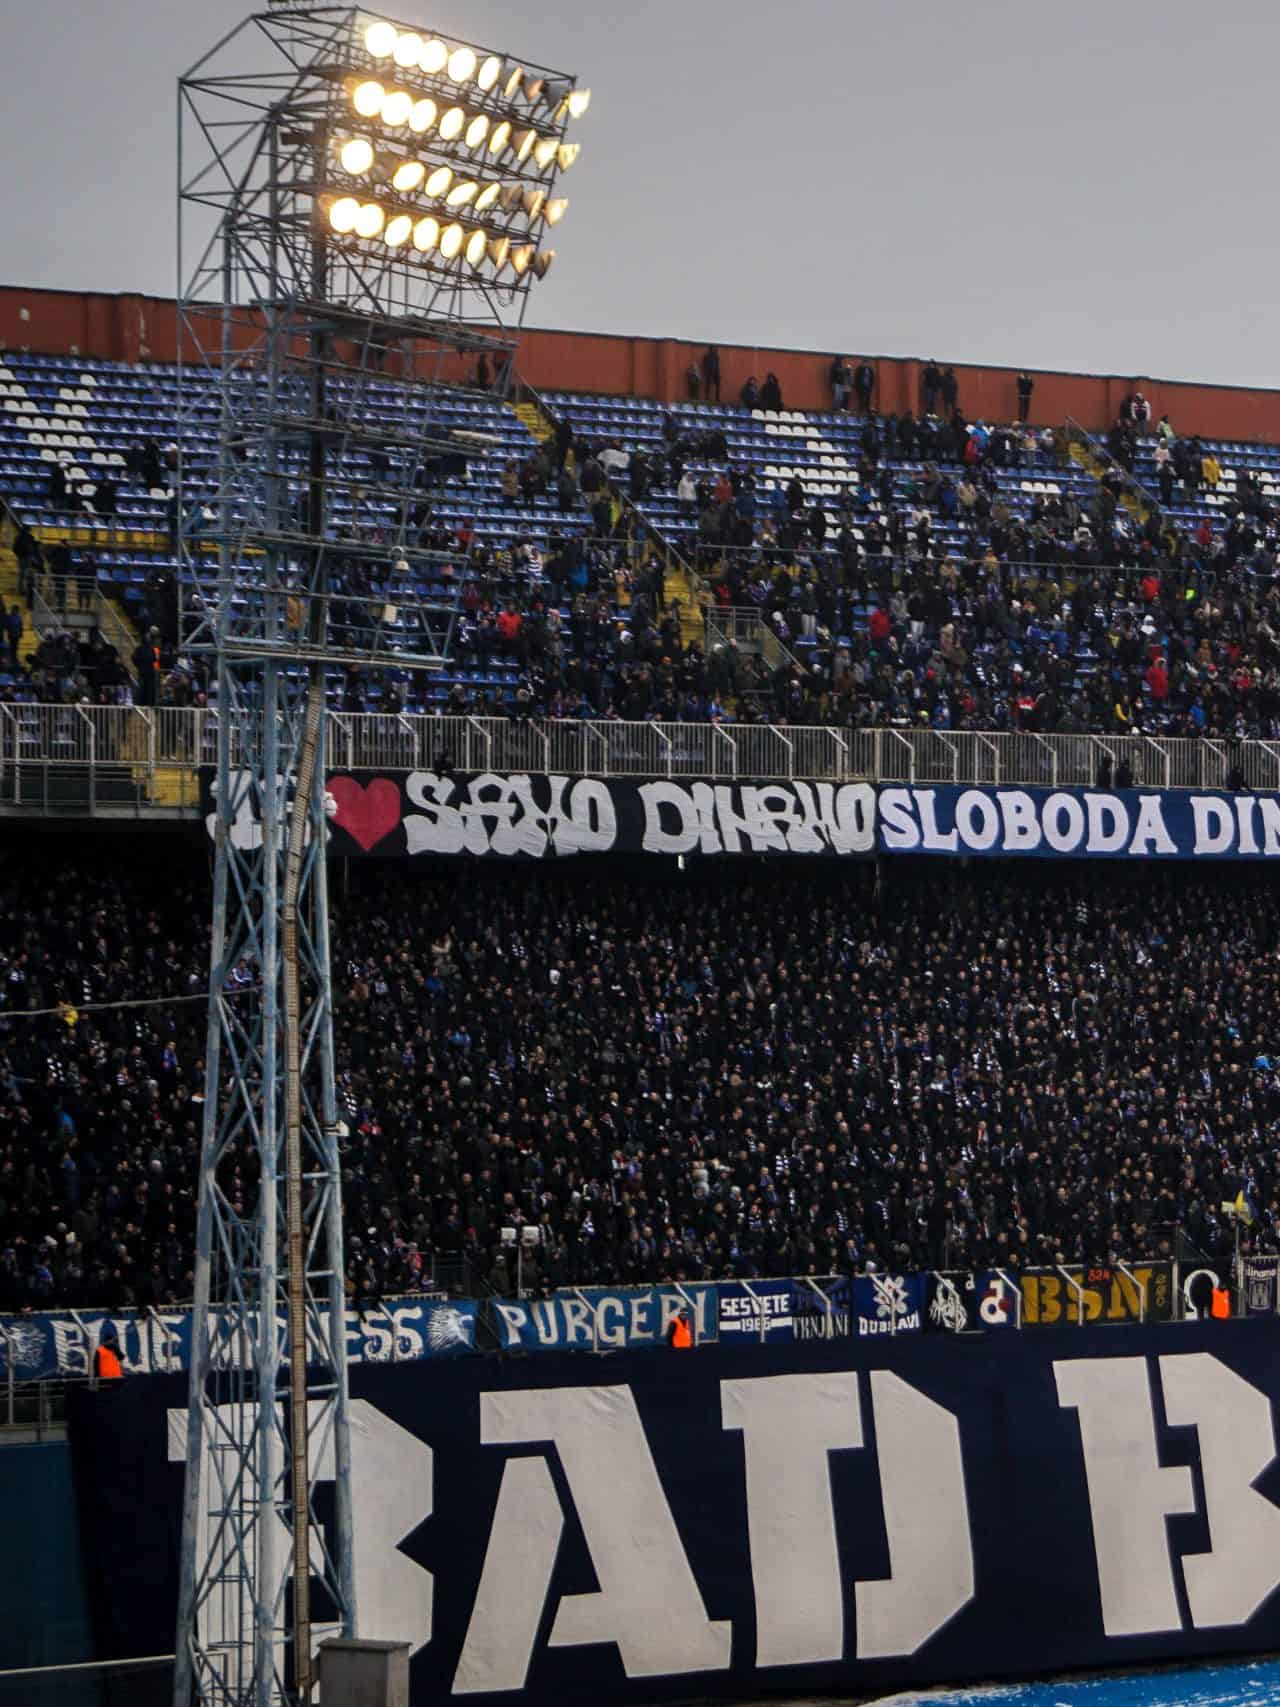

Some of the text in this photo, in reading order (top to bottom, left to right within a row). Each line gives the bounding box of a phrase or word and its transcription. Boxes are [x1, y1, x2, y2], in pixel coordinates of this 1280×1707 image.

[403, 772, 616, 855] SAMO
[638, 780, 876, 854] DINAMO
[880, 789, 1178, 854] SLOBODA
[496, 1291, 707, 1347] PURGERI
[720, 1294, 791, 1316] SESVETE
[1020, 1268, 1152, 1323] BSN
[49, 1314, 185, 1374] BLUE
[167, 1370, 974, 1705] BAD
